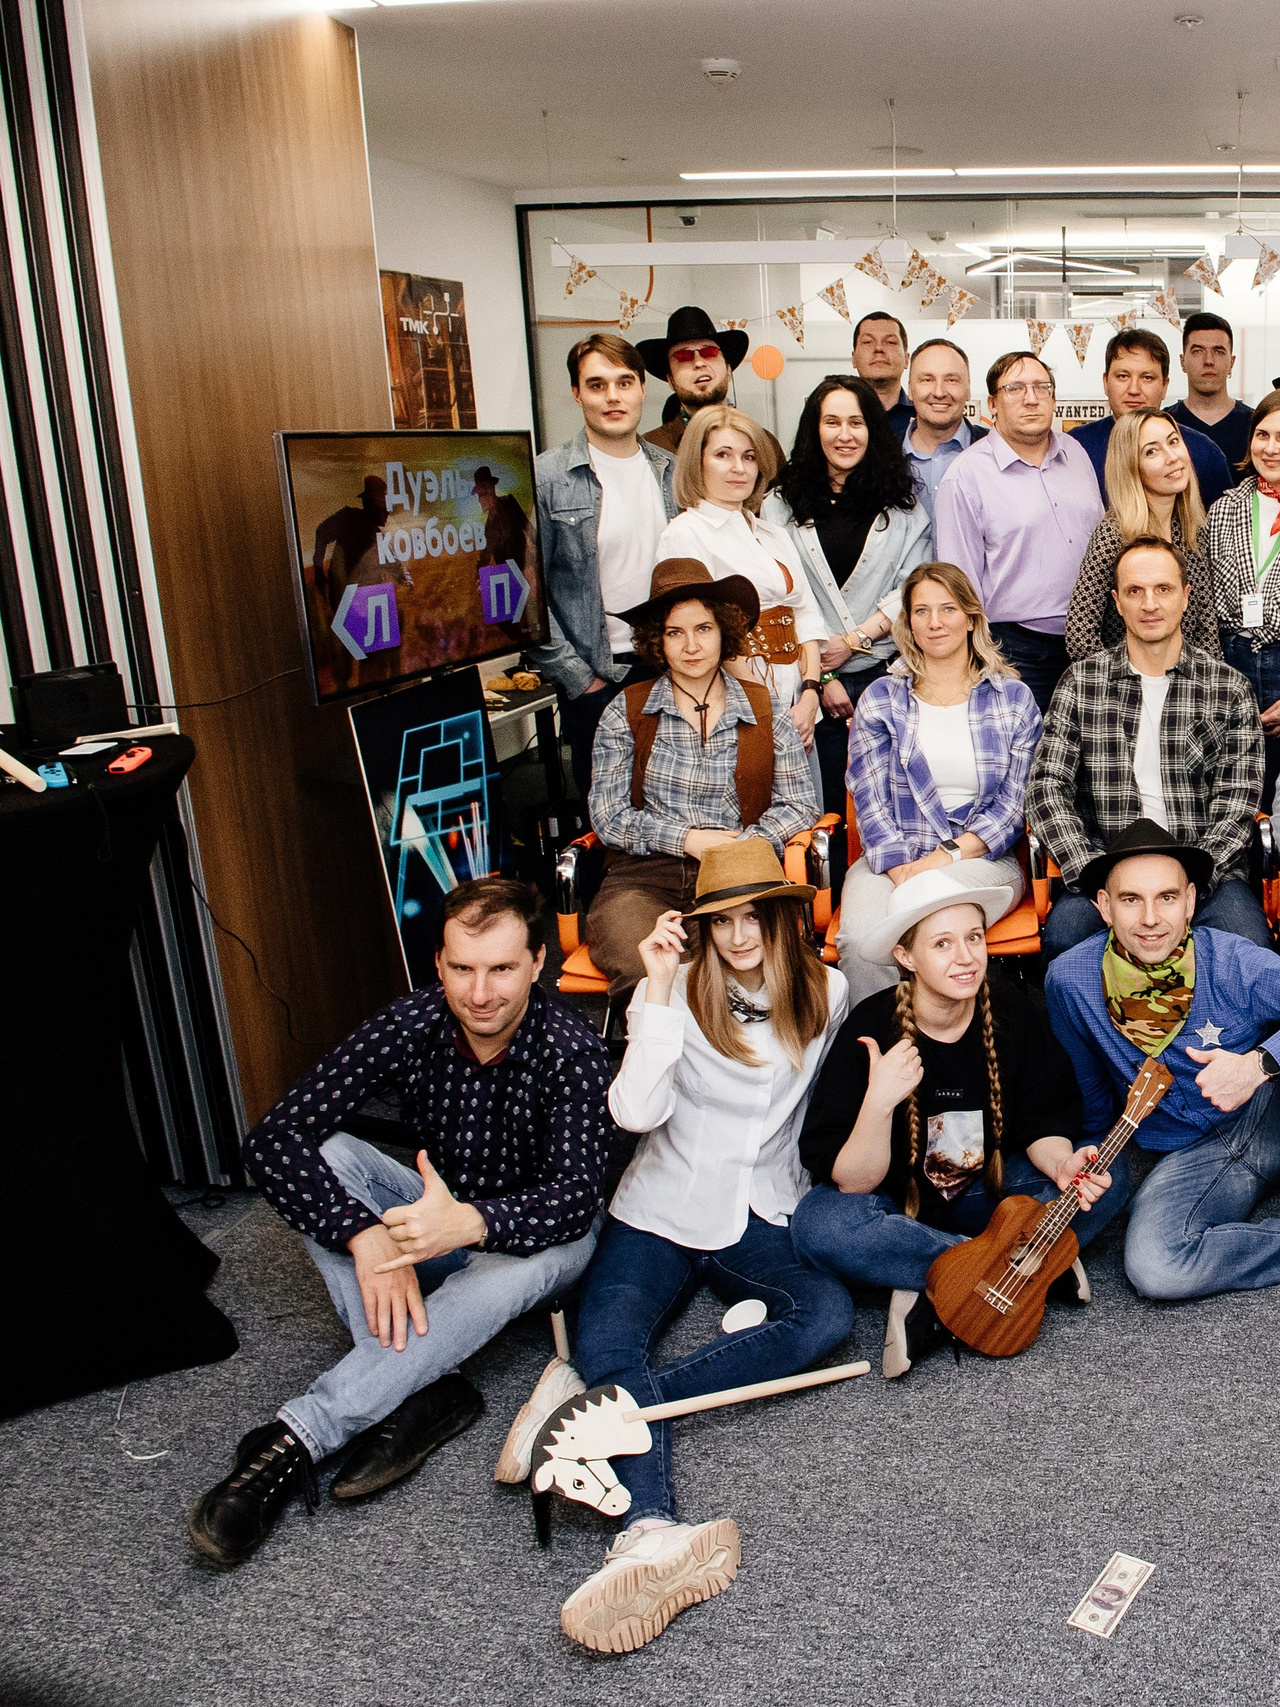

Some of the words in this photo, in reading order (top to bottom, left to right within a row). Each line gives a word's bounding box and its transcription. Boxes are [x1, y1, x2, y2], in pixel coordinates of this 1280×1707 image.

[1055, 405, 1105, 418] WANTED
[385, 462, 473, 517] Дуэль
[376, 516, 487, 565] ковбоев
